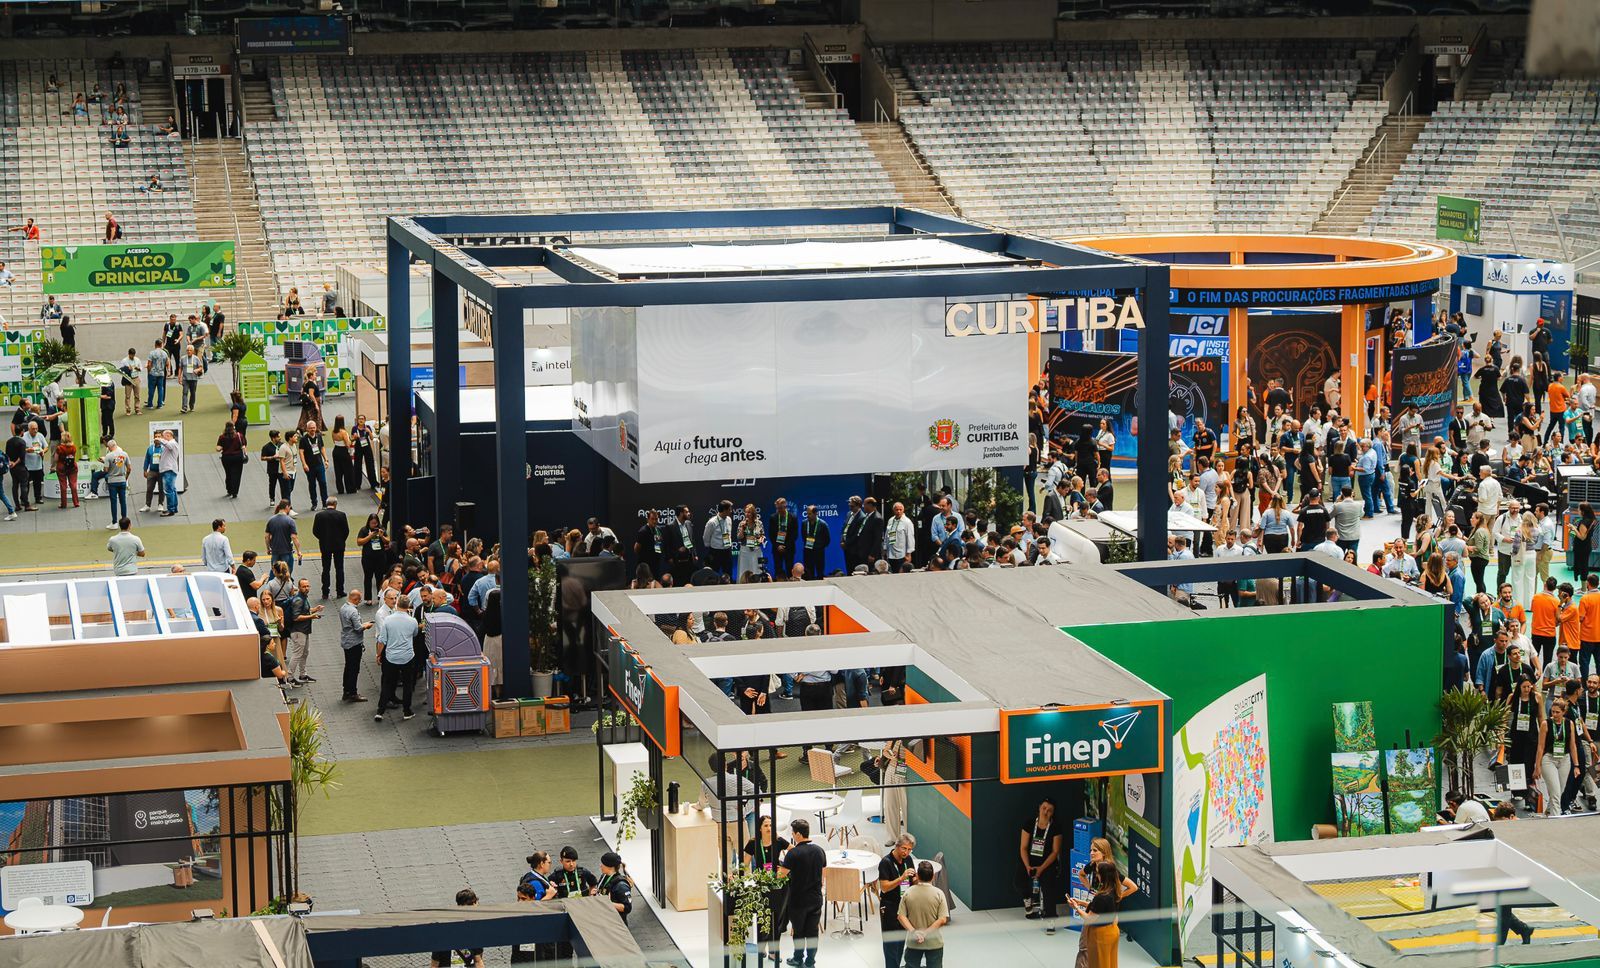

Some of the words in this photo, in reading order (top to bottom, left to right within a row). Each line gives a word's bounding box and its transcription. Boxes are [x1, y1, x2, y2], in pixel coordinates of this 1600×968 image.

[110, 254, 166, 269] PALCO
[95, 270, 183, 285] PRINCIPAL
[1187, 291, 1196, 302] O
[1199, 291, 1220, 302] FIM
[1224, 291, 1248, 302] DAS
[1252, 288, 1336, 304] PROCURAÇÕES
[1338, 284, 1410, 300] FRAGMENTADAS
[946, 296, 1146, 338] CURITIBA
[1188, 316, 1224, 334] ICI
[1169, 339, 1206, 357] ICI
[1180, 361, 1213, 372] 11h30
[968, 423, 1006, 431] Prefeitura
[654, 439, 682, 454] Aqui
[684, 442, 692, 450] o
[694, 436, 742, 450] futuro
[967, 432, 1018, 442] CURITIBA
[684, 452, 718, 466] chega
[720, 448, 767, 462] antes.
[624, 670, 642, 715] Finep
[1026, 733, 1111, 767] Finep
